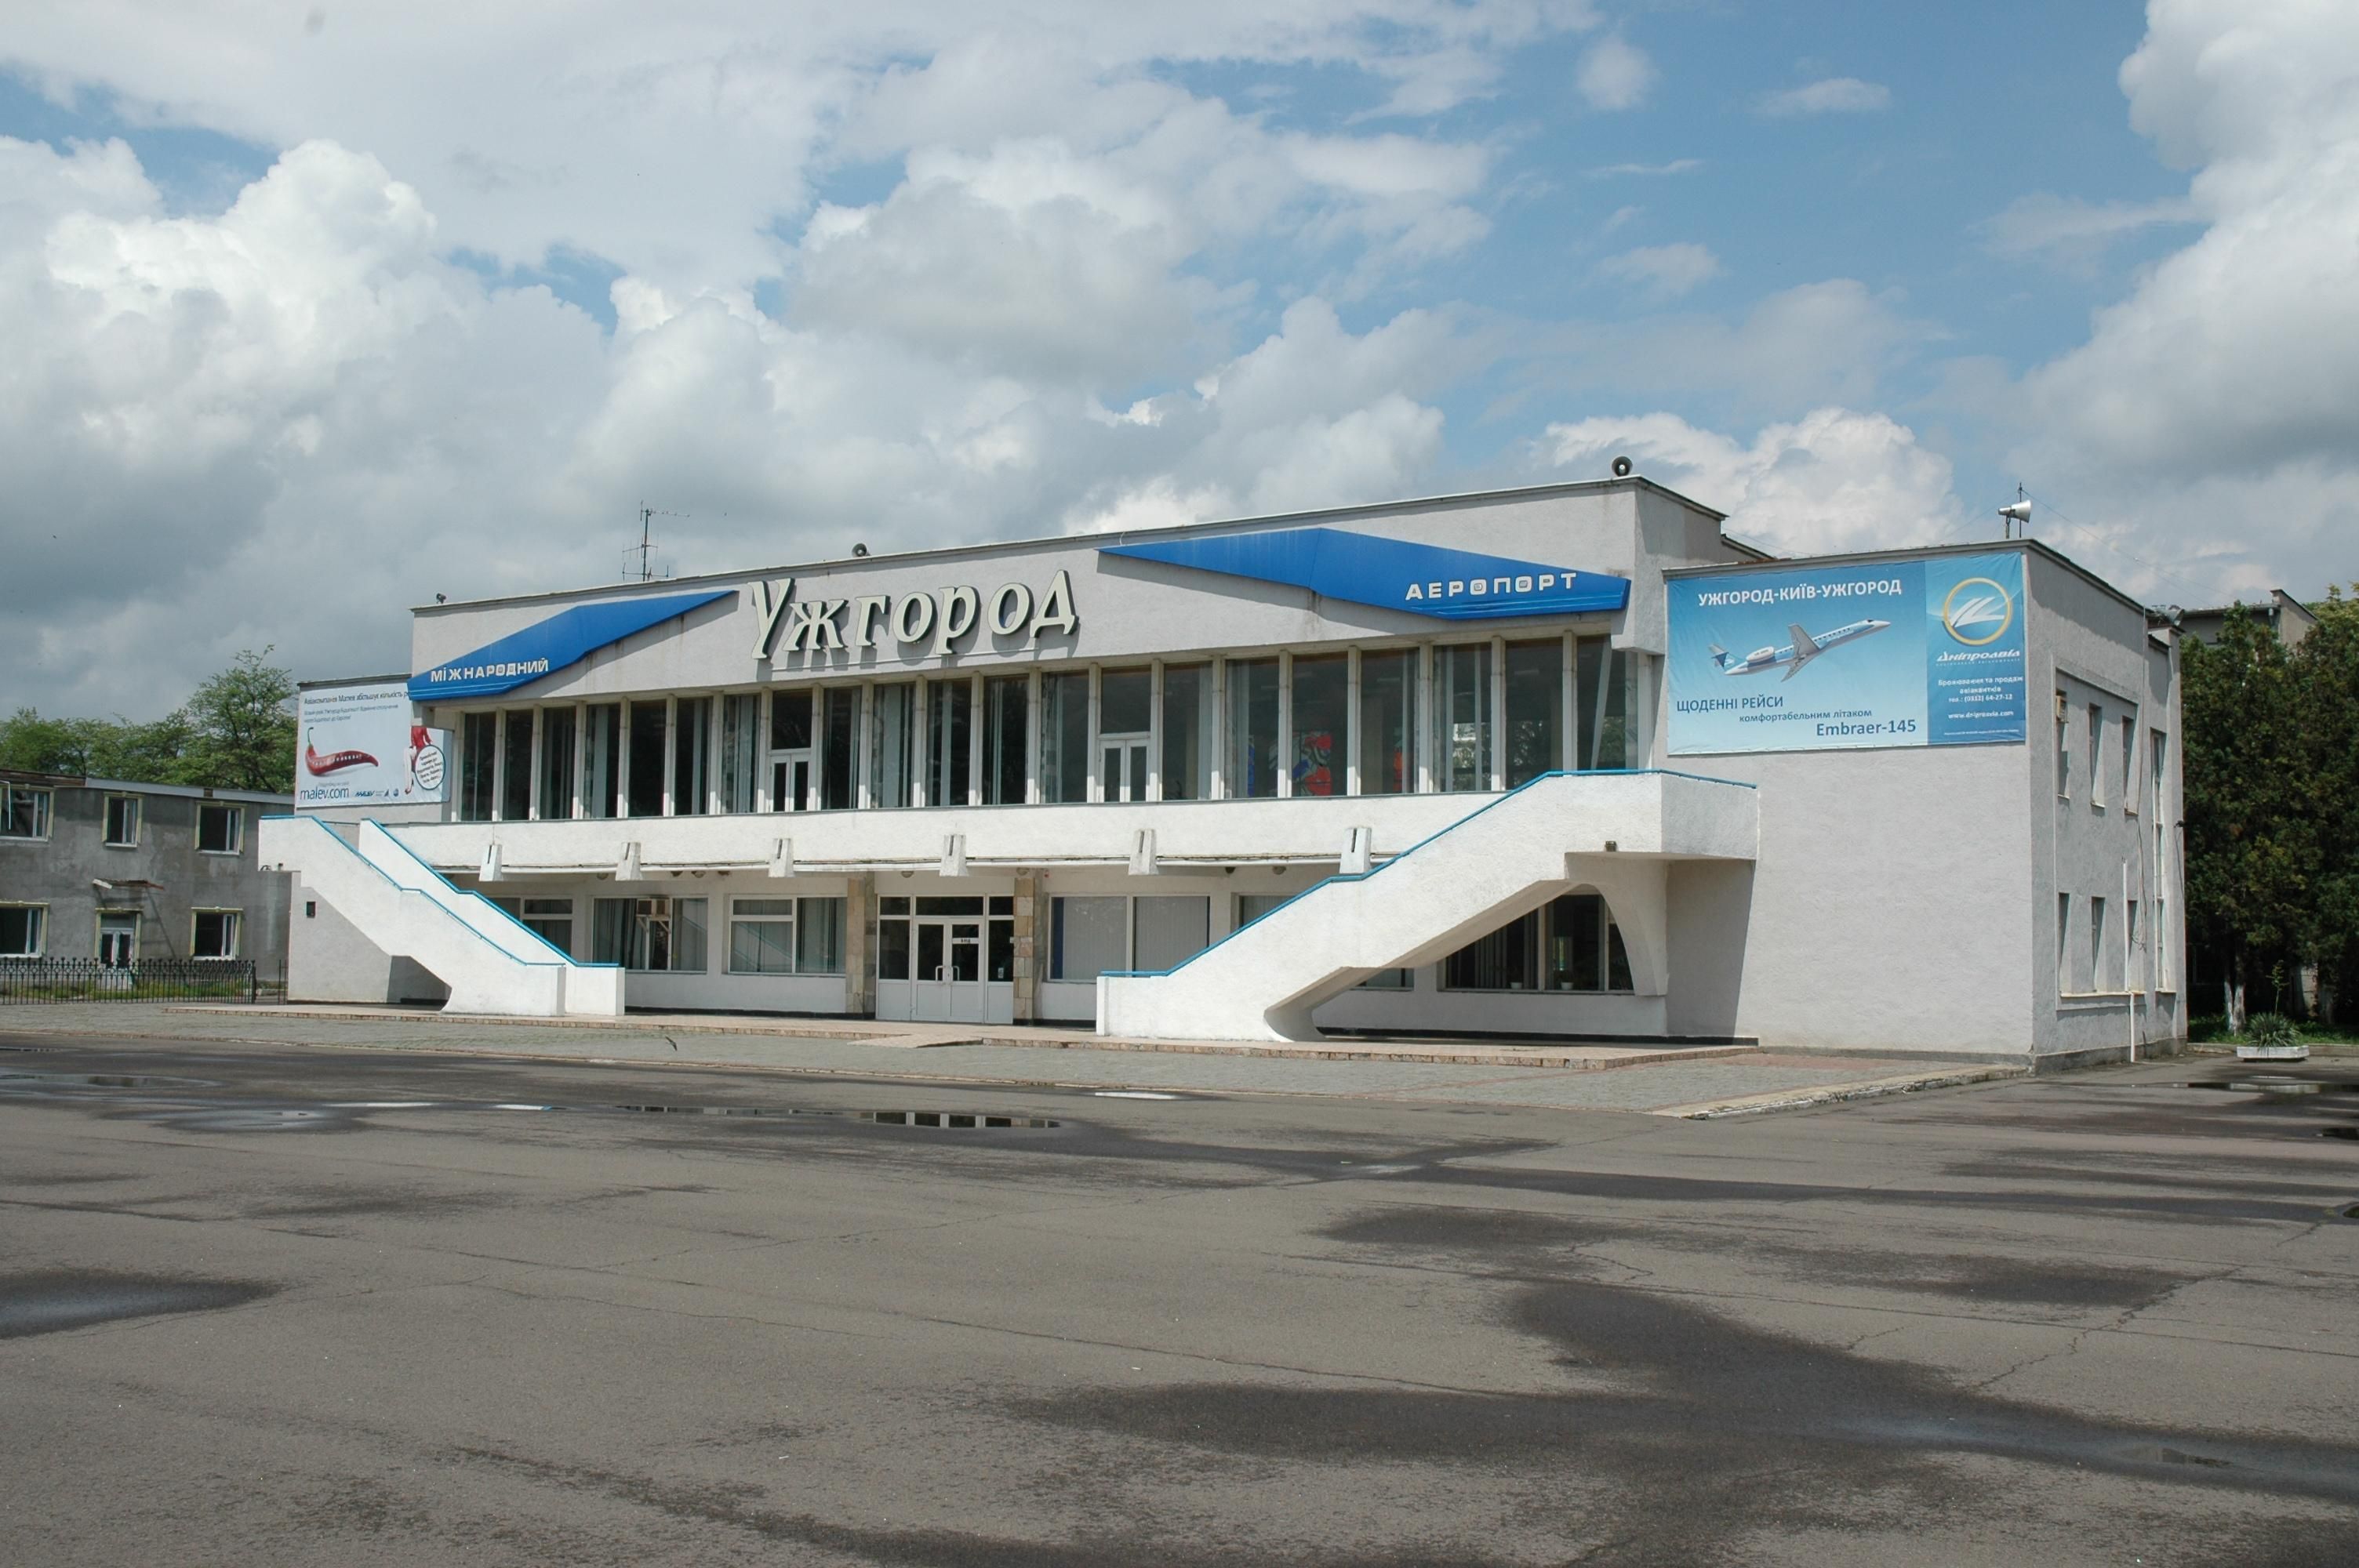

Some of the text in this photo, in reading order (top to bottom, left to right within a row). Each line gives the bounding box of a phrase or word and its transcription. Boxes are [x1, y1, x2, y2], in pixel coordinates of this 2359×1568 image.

[1405, 572, 1577, 601] АЕРОПОРТ
[1698, 579, 1903, 607] УЖГОРОД-КИЇВ-УЖГОРОД
[747, 569, 1080, 659] Ужгород
[1677, 695, 1784, 713] ЩОДЕННІ РЕЙСИ
[1739, 709, 1873, 723] комфортабельним літаком
[1816, 719, 1917, 736] Embraer-145
[300, 786, 350, 800] malev.com
